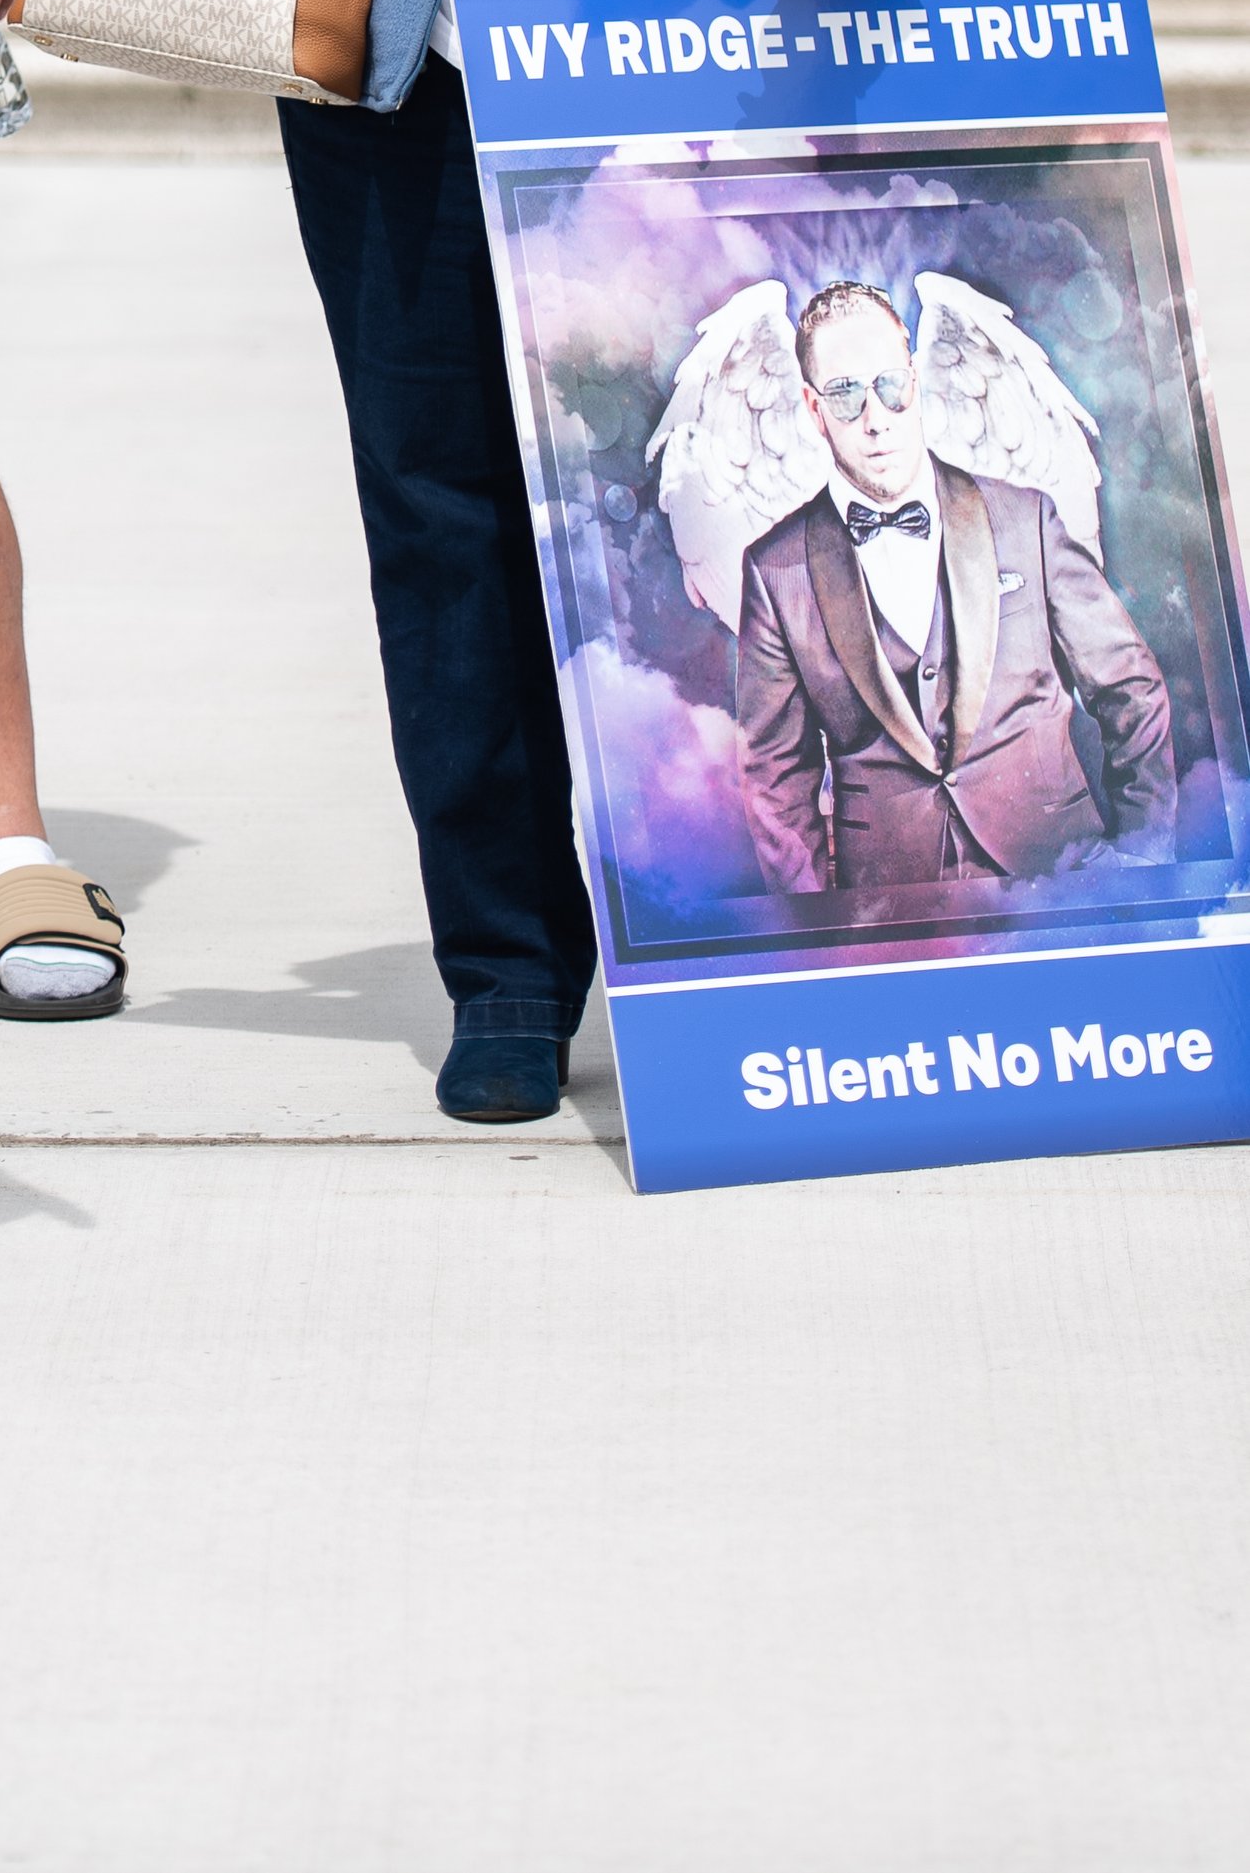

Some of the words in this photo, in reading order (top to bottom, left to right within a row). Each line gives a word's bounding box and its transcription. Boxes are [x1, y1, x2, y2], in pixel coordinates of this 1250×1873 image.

[489, 22, 589, 81] IVY
[939, 2, 1129, 62] TRUTH
[741, 1042, 940, 1110] Silent
[948, 1032, 1040, 1091] No
[1051, 1023, 1213, 1083] More
